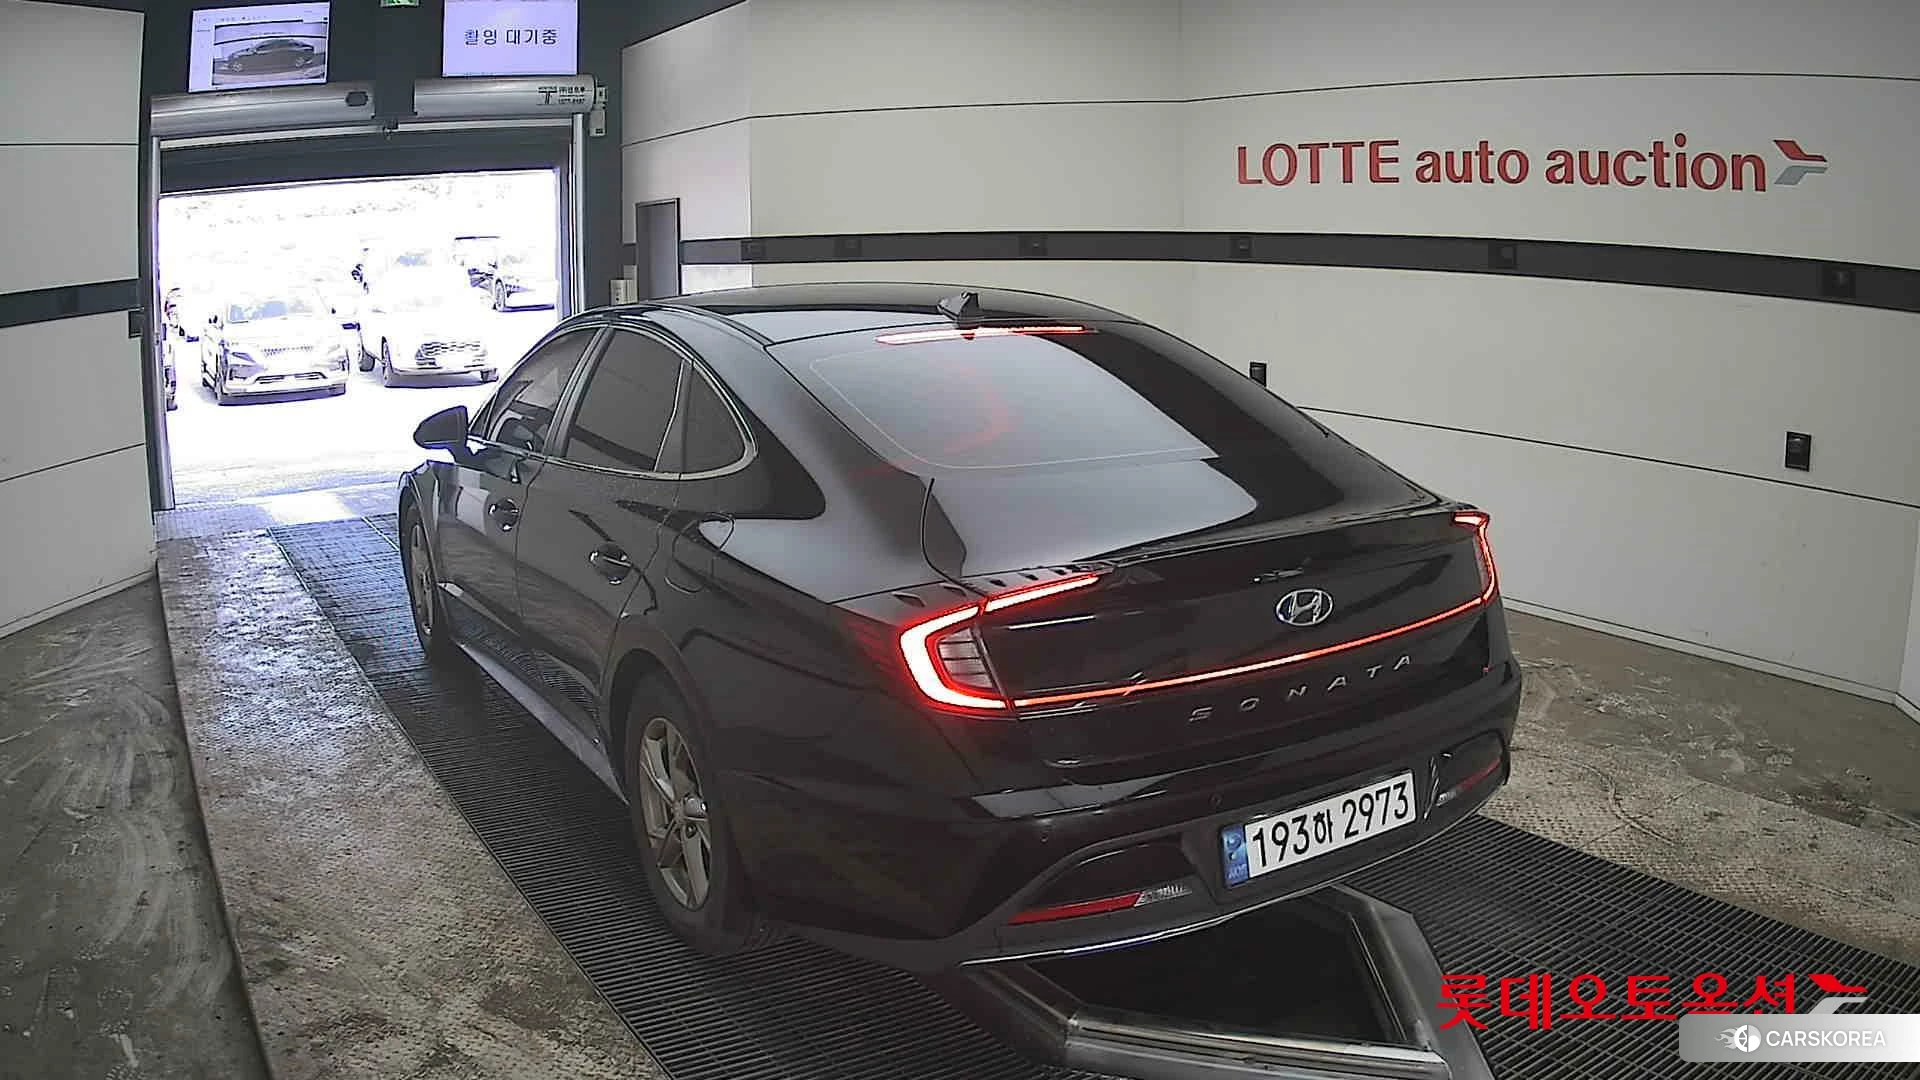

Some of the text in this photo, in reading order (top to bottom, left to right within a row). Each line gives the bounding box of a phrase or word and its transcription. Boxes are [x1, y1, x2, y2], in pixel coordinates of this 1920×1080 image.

[506, 29, 558, 46] 대기중
[1237, 133, 1766, 192] LOTTE auto auction
[1188, 655, 1411, 722] SONATA
[1252, 781, 1408, 867] 193하 2973
